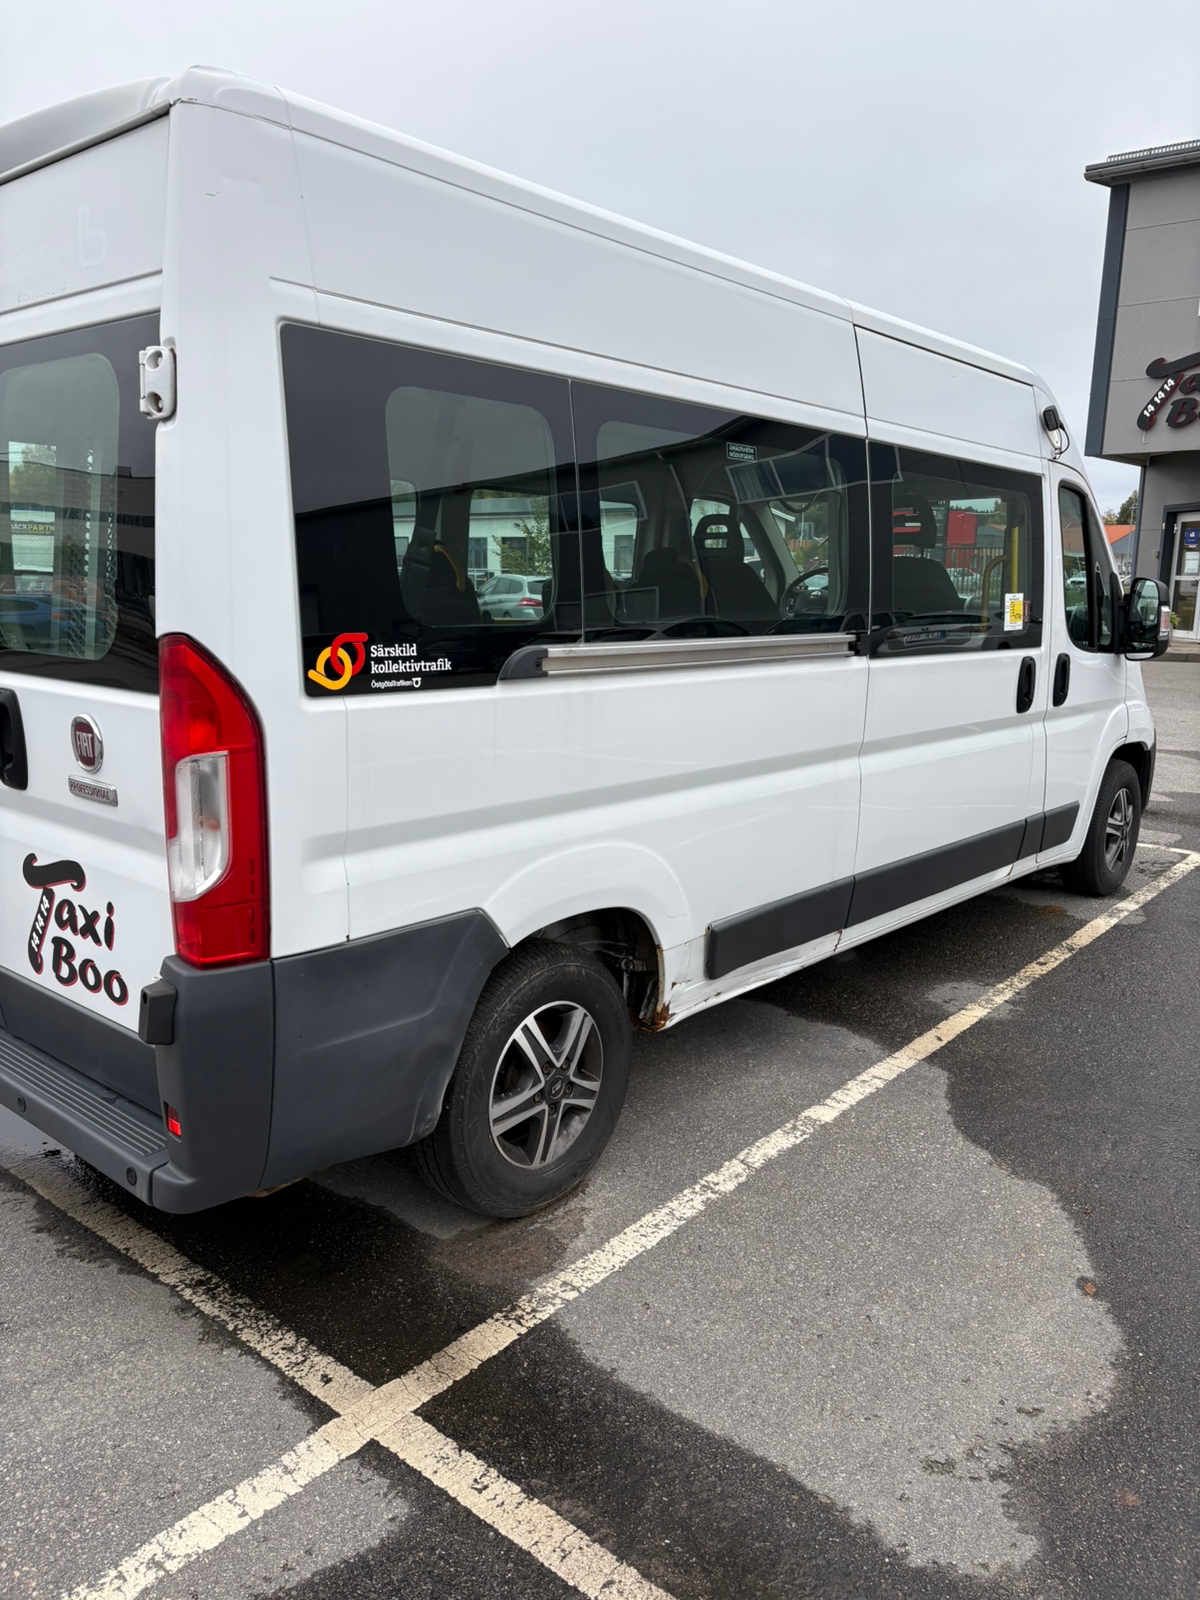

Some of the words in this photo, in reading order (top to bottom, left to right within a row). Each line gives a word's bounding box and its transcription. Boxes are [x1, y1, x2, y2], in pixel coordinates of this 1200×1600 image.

[1143, 404, 1155, 417] 14
[1154, 391, 1165, 403] 14
[1164, 378, 1174, 390] 14
[1165, 397, 1200, 429] B
[370, 643, 417, 658] Särskild
[370, 658, 452, 674] kollektivtrafik
[76, 730, 95, 759] FIAT
[69, 780, 111, 801] PROFESSIONAL
[22, 852, 116, 975] Taxi
[40, 895, 51, 913] 14
[35, 914, 46, 934] 14
[30, 931, 40, 952] 14
[51, 936, 129, 1006] Boo
